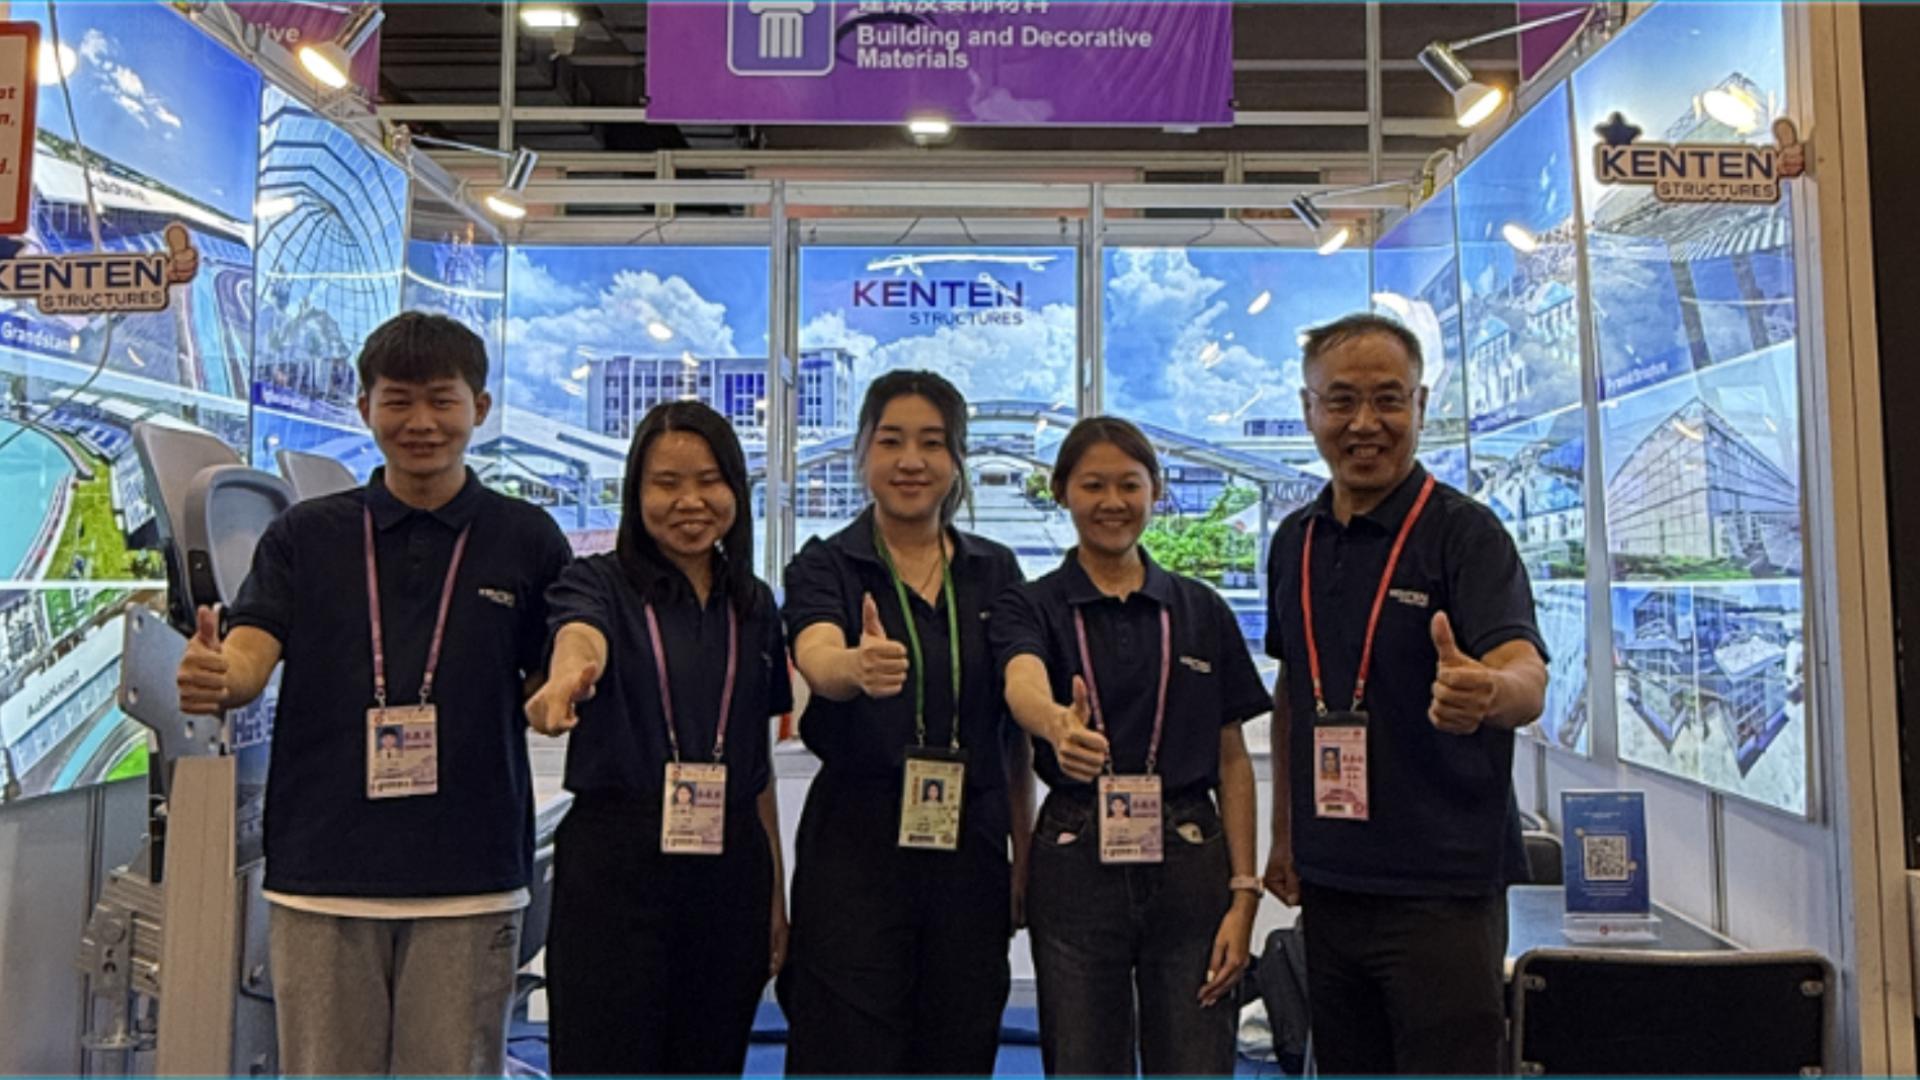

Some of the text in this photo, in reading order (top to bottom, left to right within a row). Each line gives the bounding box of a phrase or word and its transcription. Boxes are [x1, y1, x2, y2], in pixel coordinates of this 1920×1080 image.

[857, 25, 1152, 50] Building and Decorative
[857, 48, 969, 69] Materials
[1602, 150, 1773, 178] KENTEN
[1661, 182, 1774, 197] STRUCTURES
[44, 291, 162, 308] STRUCTURES
[854, 280, 1023, 307] KENTEN
[910, 311, 1024, 326] STRUCTURES
